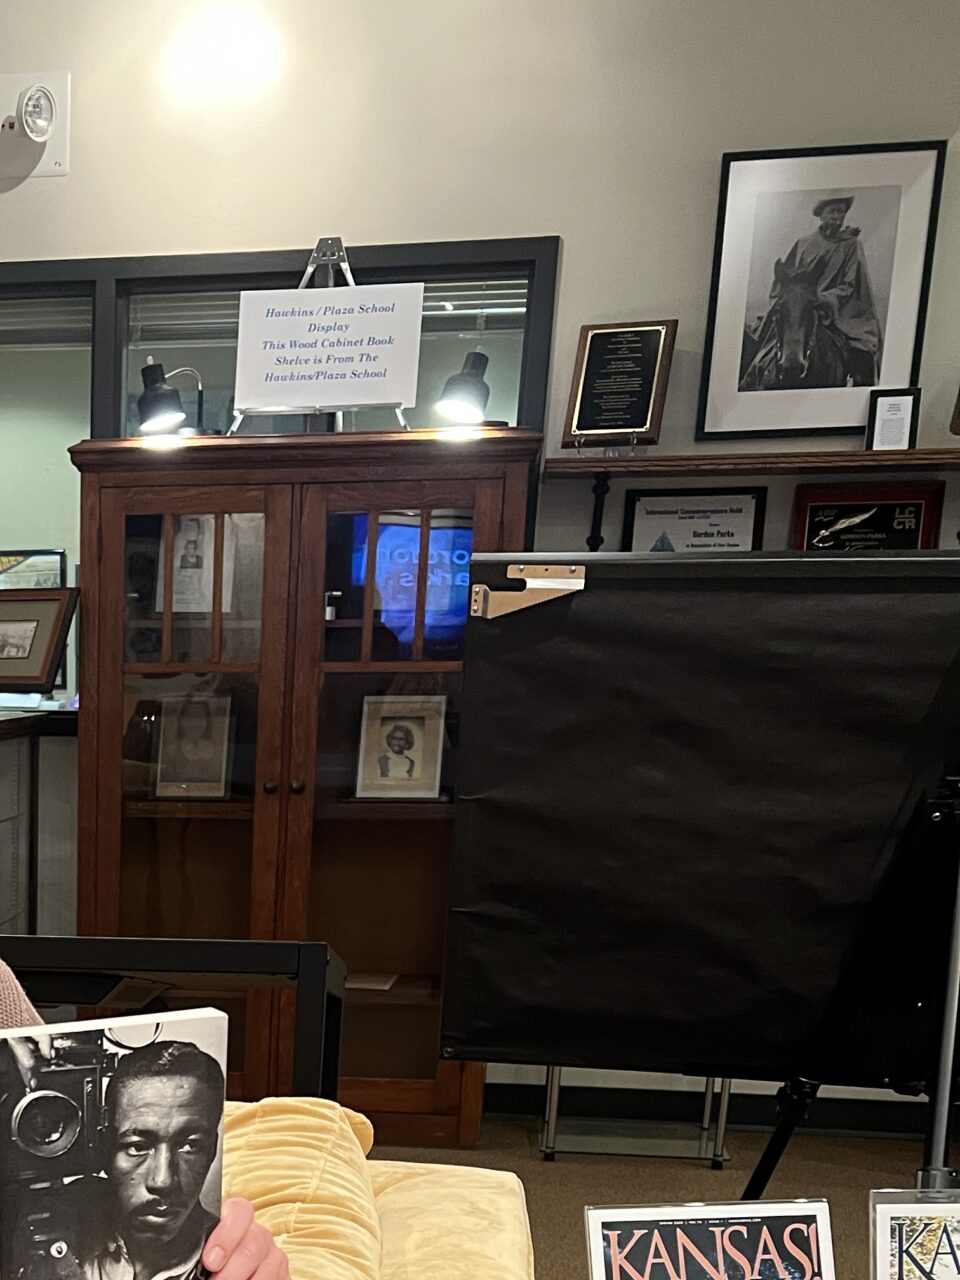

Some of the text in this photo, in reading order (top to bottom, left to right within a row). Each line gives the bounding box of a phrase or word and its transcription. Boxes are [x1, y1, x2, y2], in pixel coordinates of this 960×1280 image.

[265, 307, 314, 318] Hawkins
[323, 305, 354, 316] Plaza
[358, 303, 395, 314] School
[307, 322, 350, 333] Display
[262, 336, 394, 350] This Wood Cabinet Book
[275, 353, 378, 366] Shelve is From The
[264, 368, 387, 382] Hawkins/Plaza School
